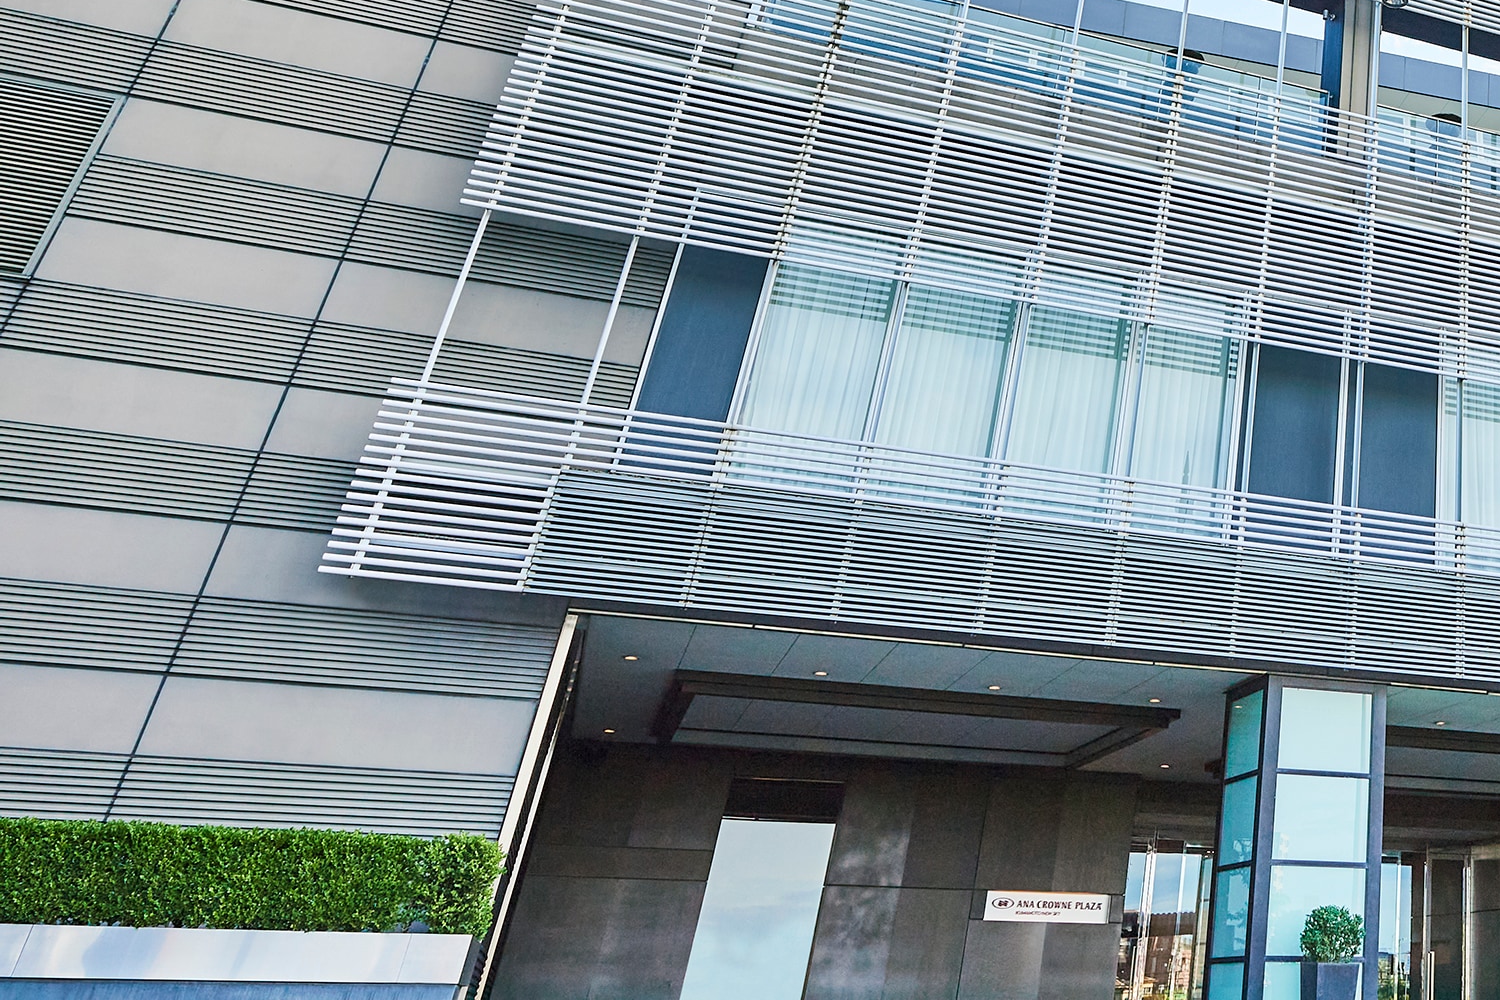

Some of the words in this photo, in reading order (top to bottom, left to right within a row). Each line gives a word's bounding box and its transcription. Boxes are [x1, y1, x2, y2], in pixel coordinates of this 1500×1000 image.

[1016, 900, 1035, 909] ANA
[1036, 900, 1072, 910] CROWNE
[1074, 901, 1103, 911] PLAZA
